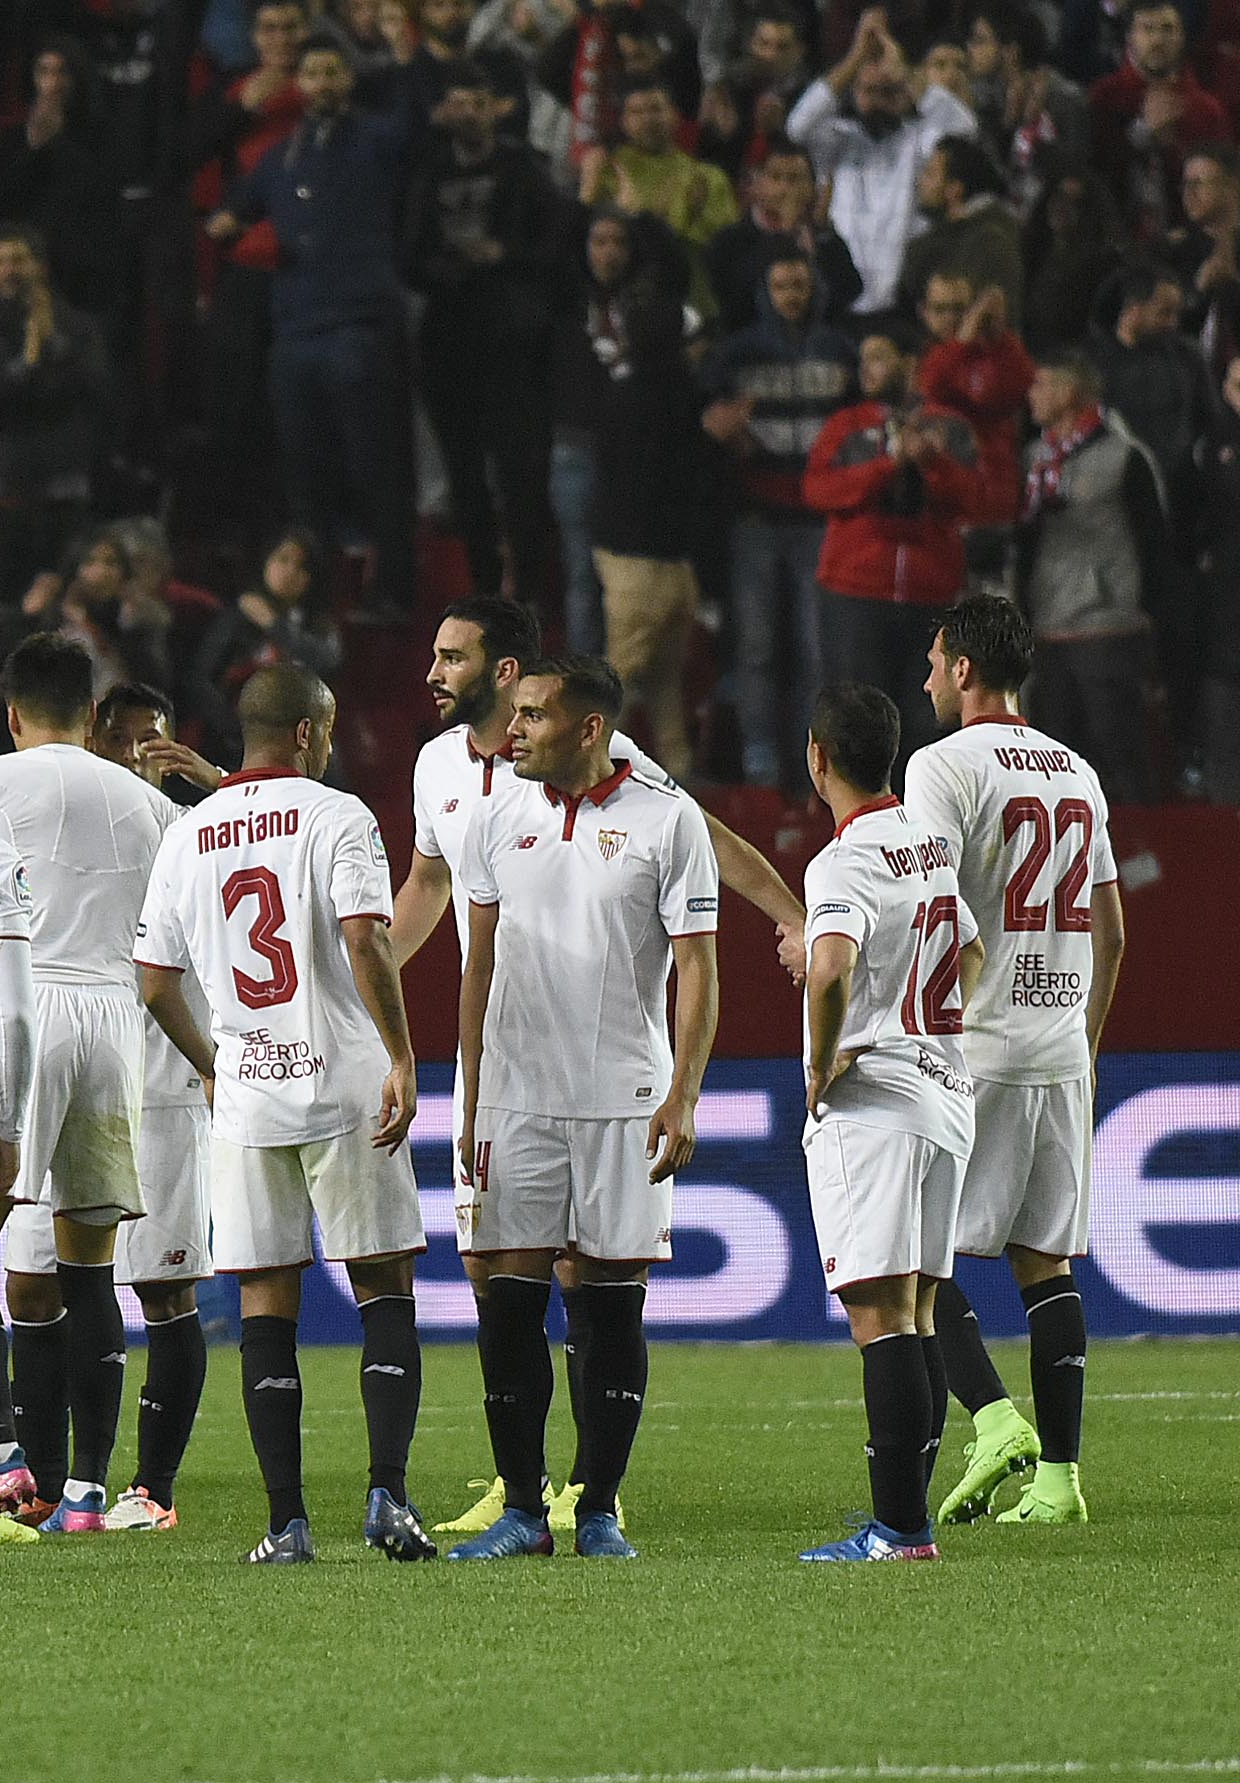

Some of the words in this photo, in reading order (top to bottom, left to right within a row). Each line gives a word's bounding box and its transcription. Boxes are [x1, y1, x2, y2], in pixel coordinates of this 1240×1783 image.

[994, 747, 1078, 781] vazquez
[198, 808, 299, 855] mariano
[1002, 796, 1093, 932] 22
[221, 865, 298, 1010] 3
[900, 895, 964, 1036] 12
[1015, 954, 1045, 971] SEE
[1012, 973, 1080, 989] PUERTO
[238, 1027, 273, 1046] SEE
[241, 1041, 310, 1063] PUERTO
[238, 1054, 326, 1081] RICO.COM
